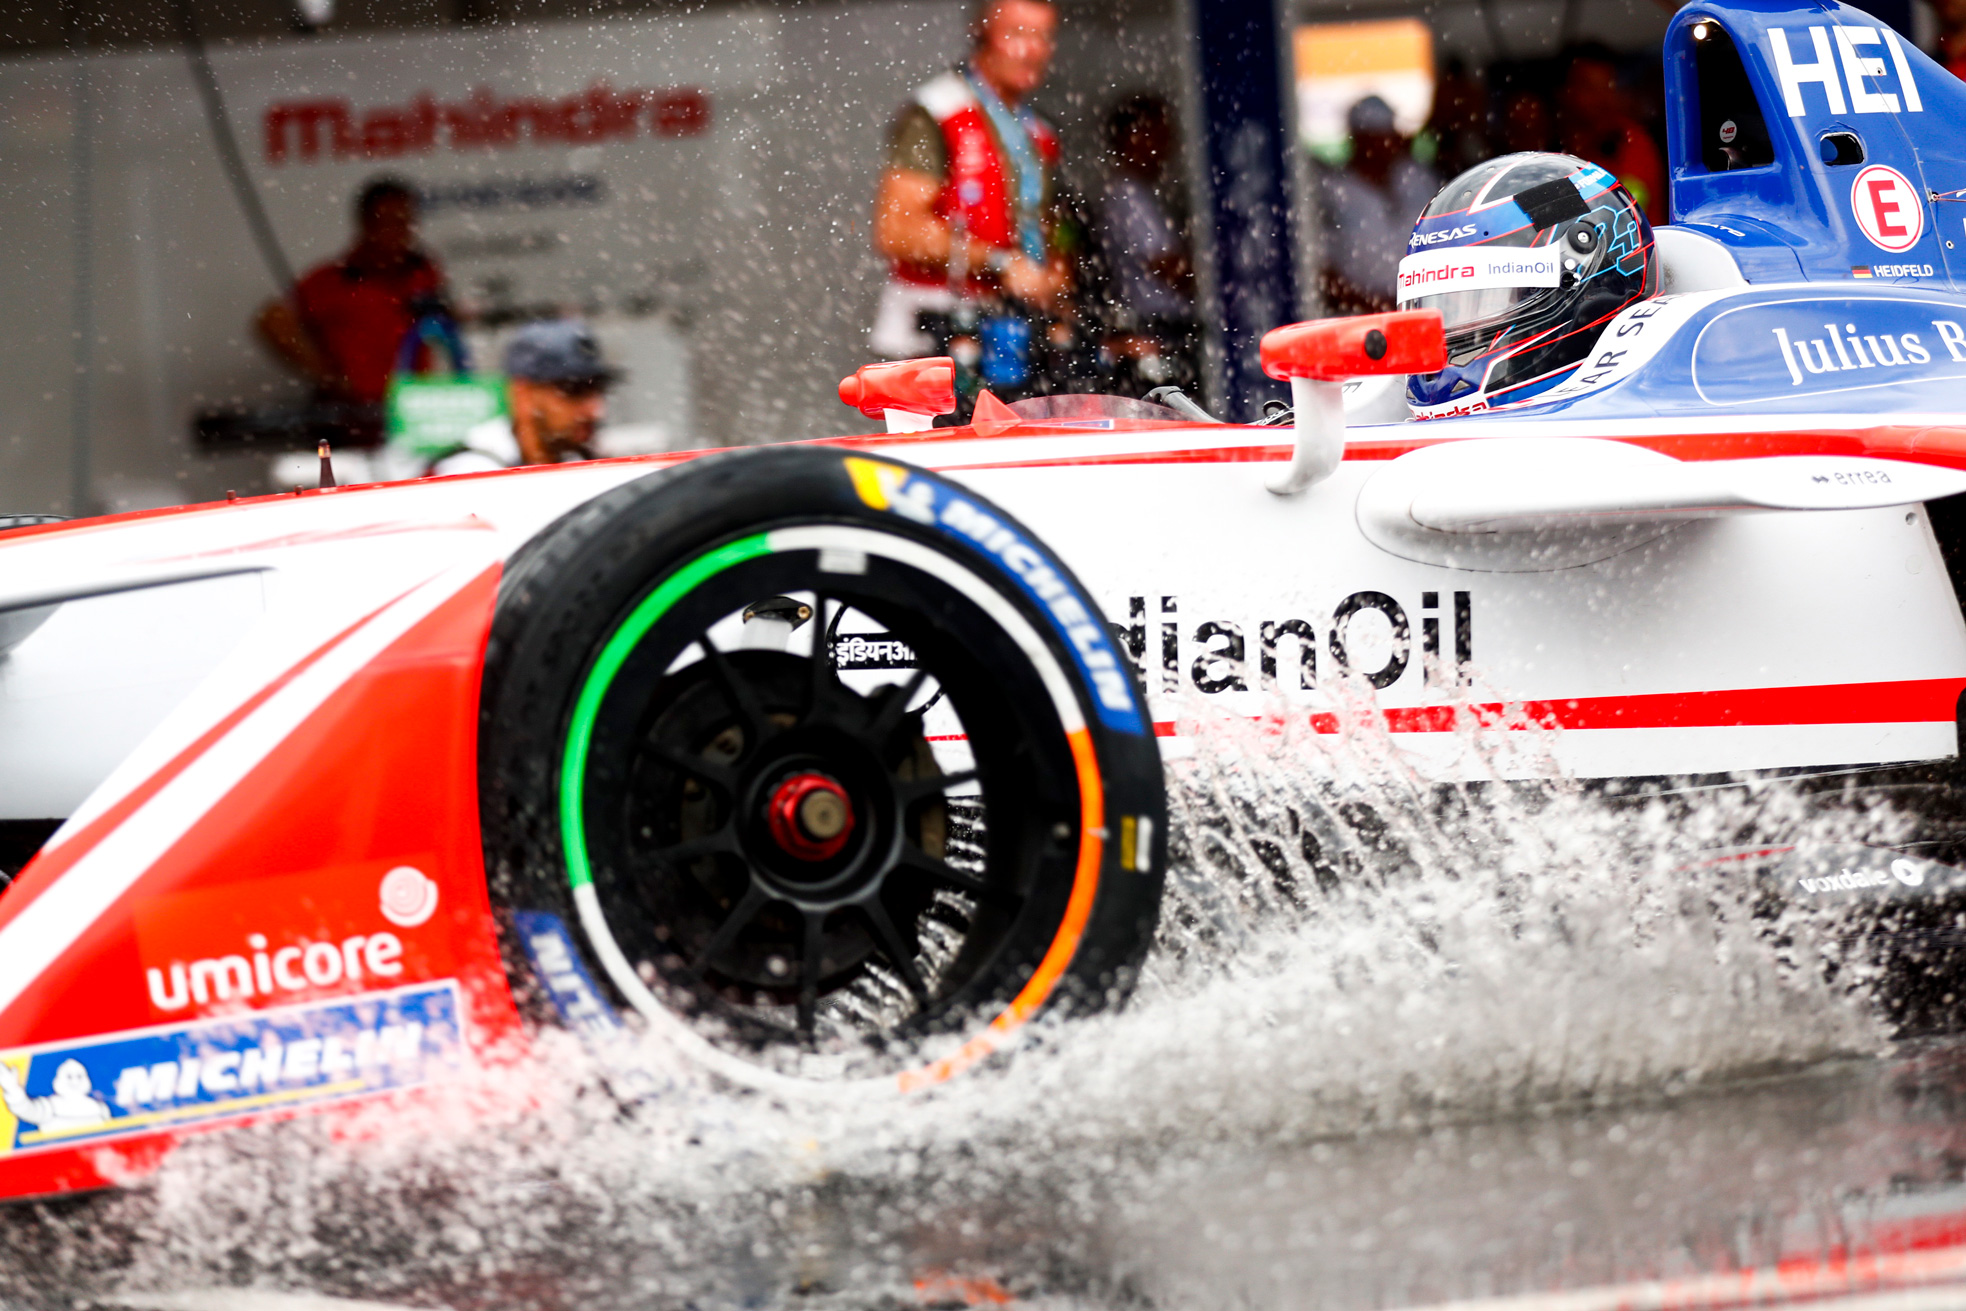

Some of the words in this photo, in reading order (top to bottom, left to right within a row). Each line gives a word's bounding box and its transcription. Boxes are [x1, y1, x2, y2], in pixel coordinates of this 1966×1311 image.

[1766, 25, 1924, 118] HEI
[1409, 223, 1477, 249] RENESAS
[1866, 179, 1908, 237] E
[1488, 261, 1554, 275] IndianOil
[1873, 264, 1934, 277] HEIDFELD
[1771, 323, 1931, 386] Julius
[941, 499, 1134, 711] MICHELIN
[147, 932, 404, 1012] umicore
[115, 1021, 424, 1107] MICHELIN
